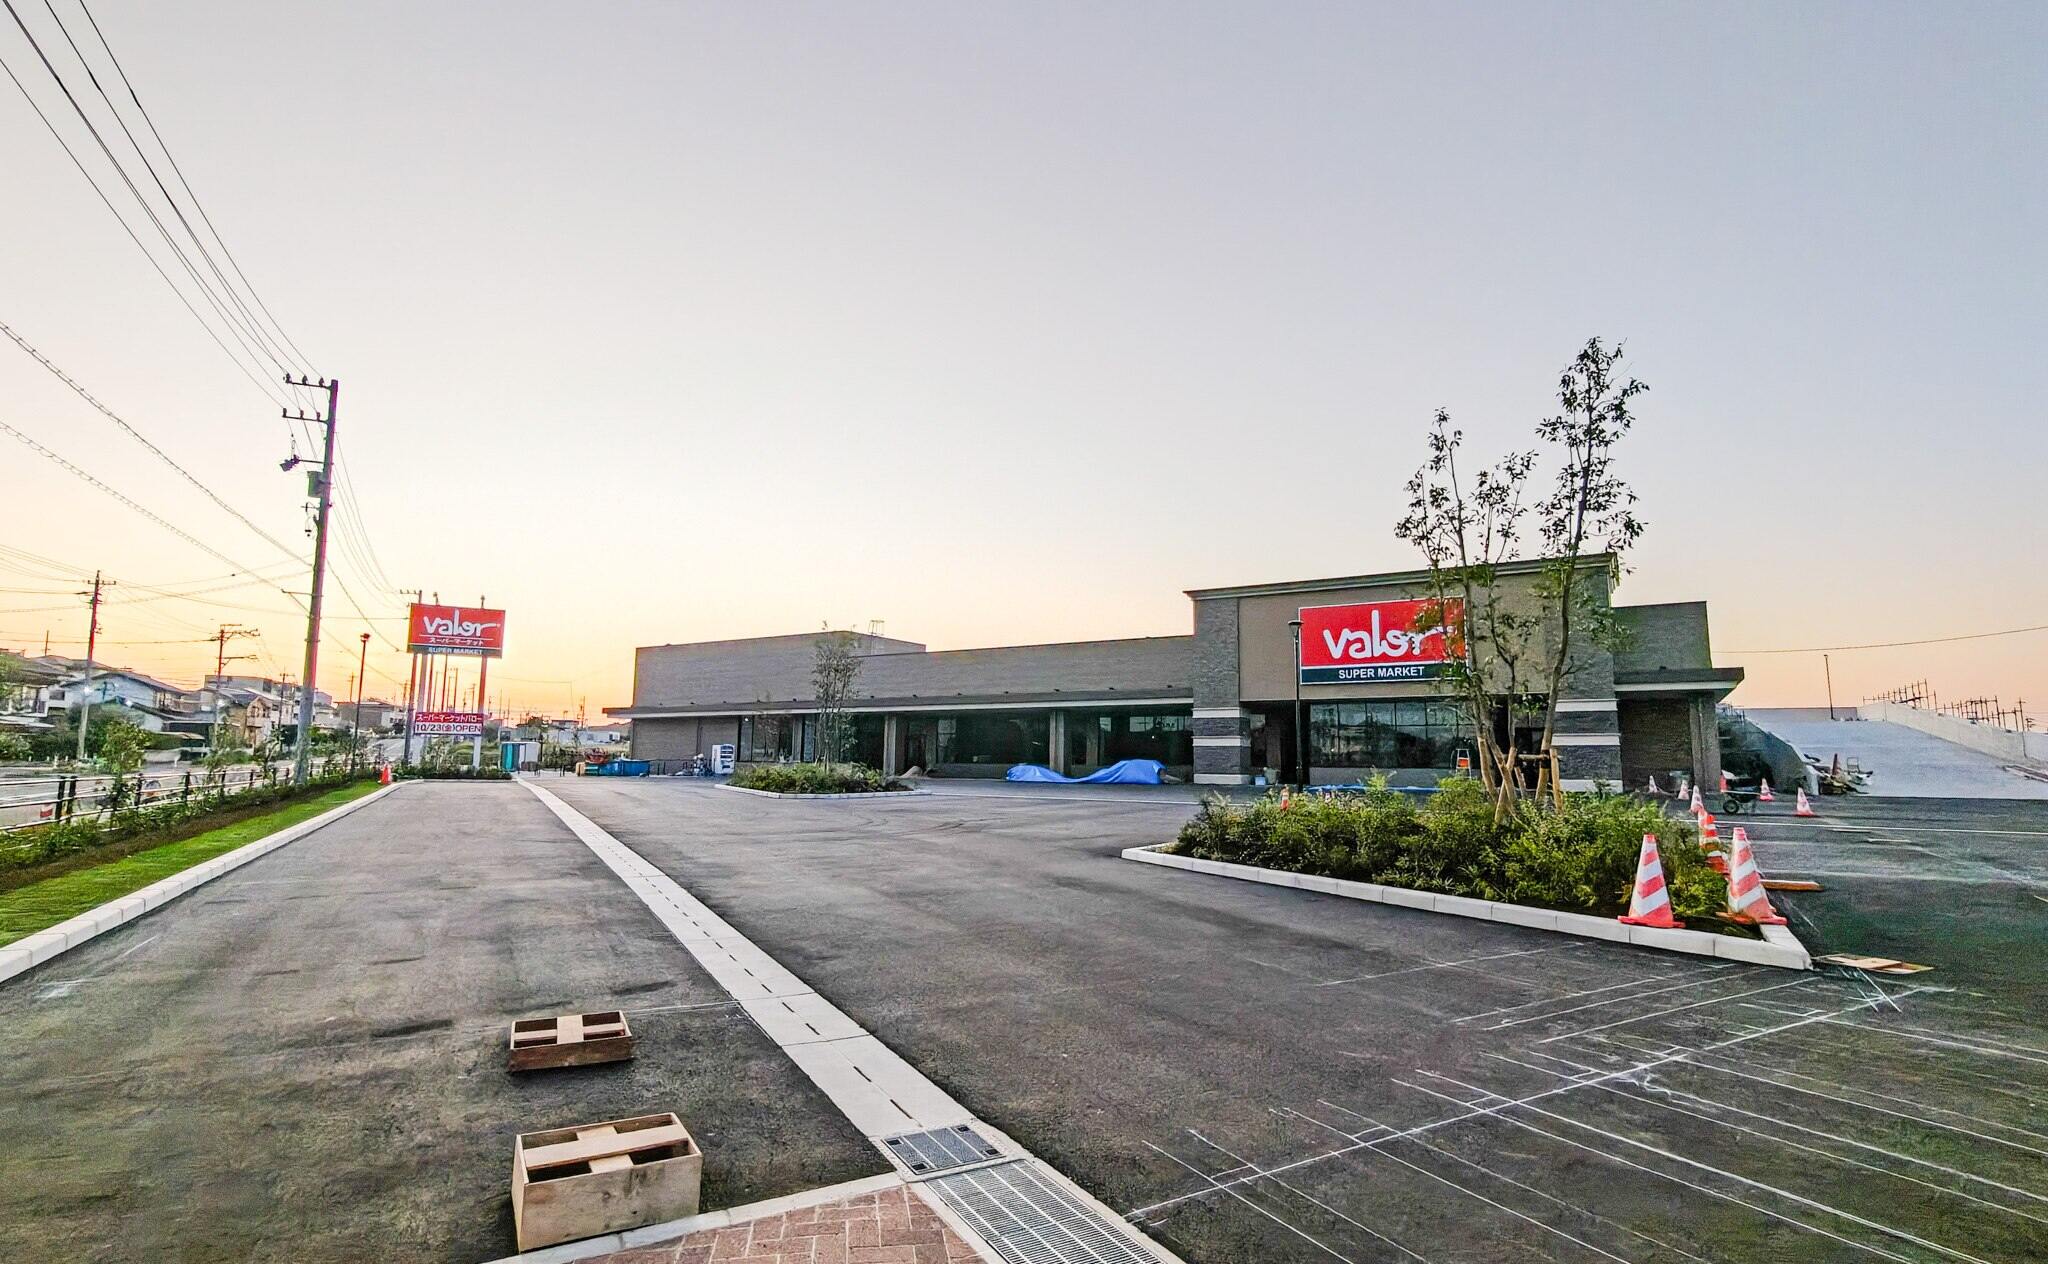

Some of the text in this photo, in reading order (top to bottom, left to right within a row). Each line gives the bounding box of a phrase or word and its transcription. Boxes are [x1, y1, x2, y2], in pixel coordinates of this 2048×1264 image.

[423, 608, 498, 637] valor
[428, 637, 485, 646] スーパーマーケット
[428, 646, 483, 655] SUPER MARKET
[1338, 666, 1425, 679] SUPER MARKET
[416, 713, 483, 723] スーパーマーケットバロー
